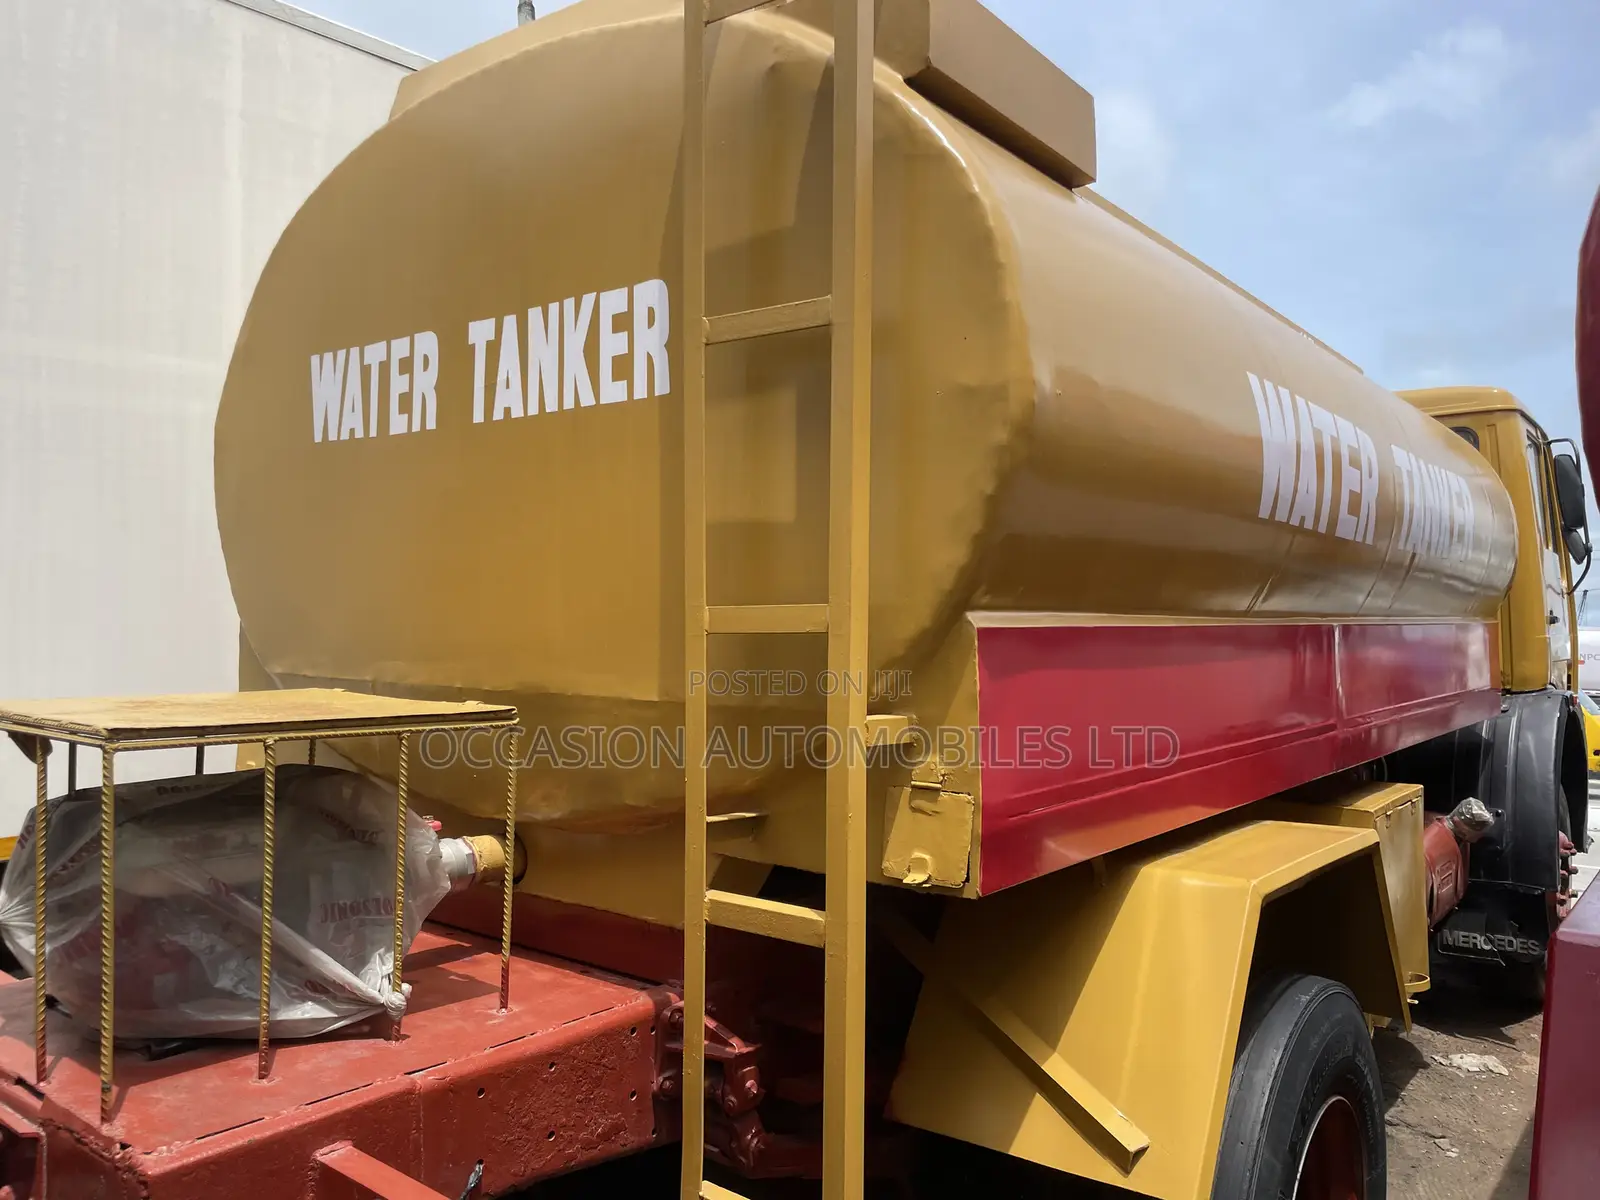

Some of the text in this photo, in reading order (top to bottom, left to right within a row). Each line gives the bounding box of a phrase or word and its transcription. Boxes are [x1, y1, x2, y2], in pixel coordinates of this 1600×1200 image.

[310, 278, 671, 443] WATER TANKER
[1246, 371, 1475, 560] WATER TANKER
[1442, 929, 1541, 955] MERCEDES
